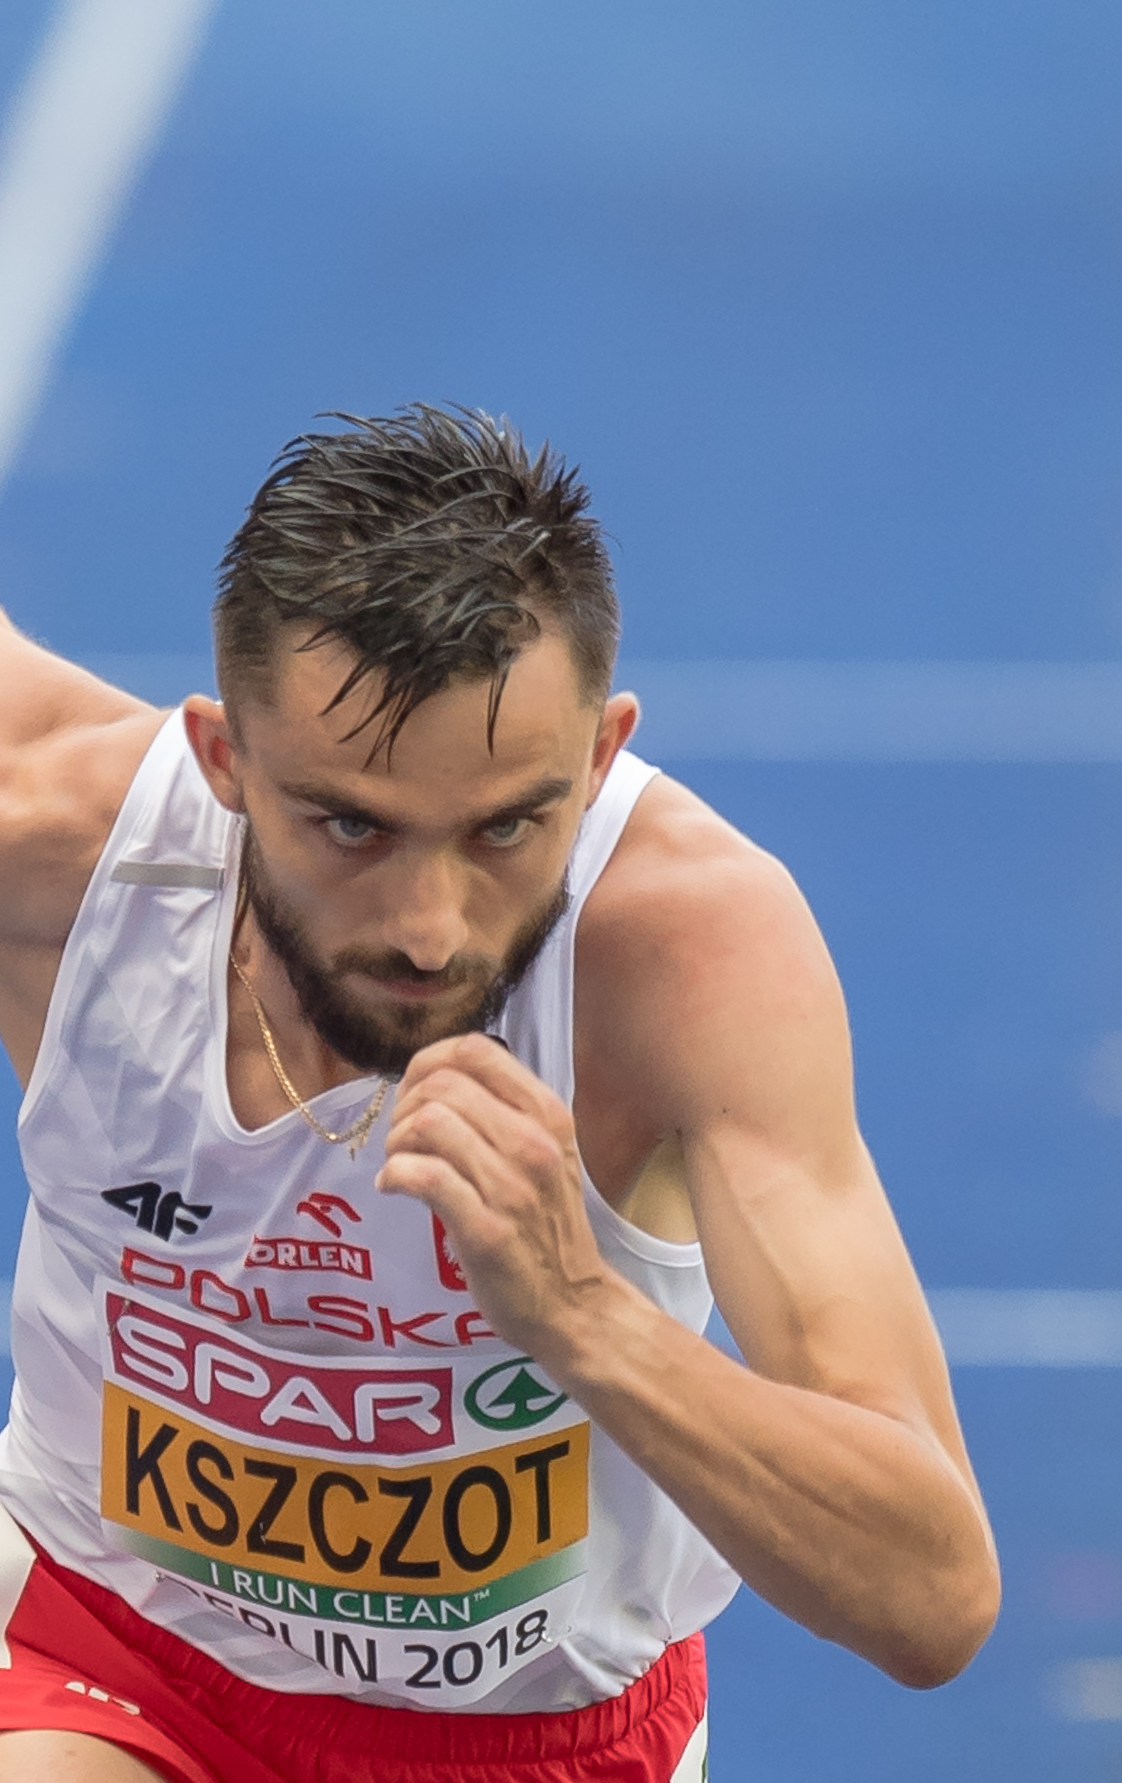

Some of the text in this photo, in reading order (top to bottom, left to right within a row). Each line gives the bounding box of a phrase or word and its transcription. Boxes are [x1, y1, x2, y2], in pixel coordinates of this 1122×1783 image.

[247, 1242, 365, 1274] ORLEN
[116, 1315, 442, 1444] SPAR
[125, 1405, 571, 1580] KSZCZOT
[210, 1562, 220, 1586] I
[233, 1569, 318, 1613] RUN
[404, 1608, 550, 1689] 2018
